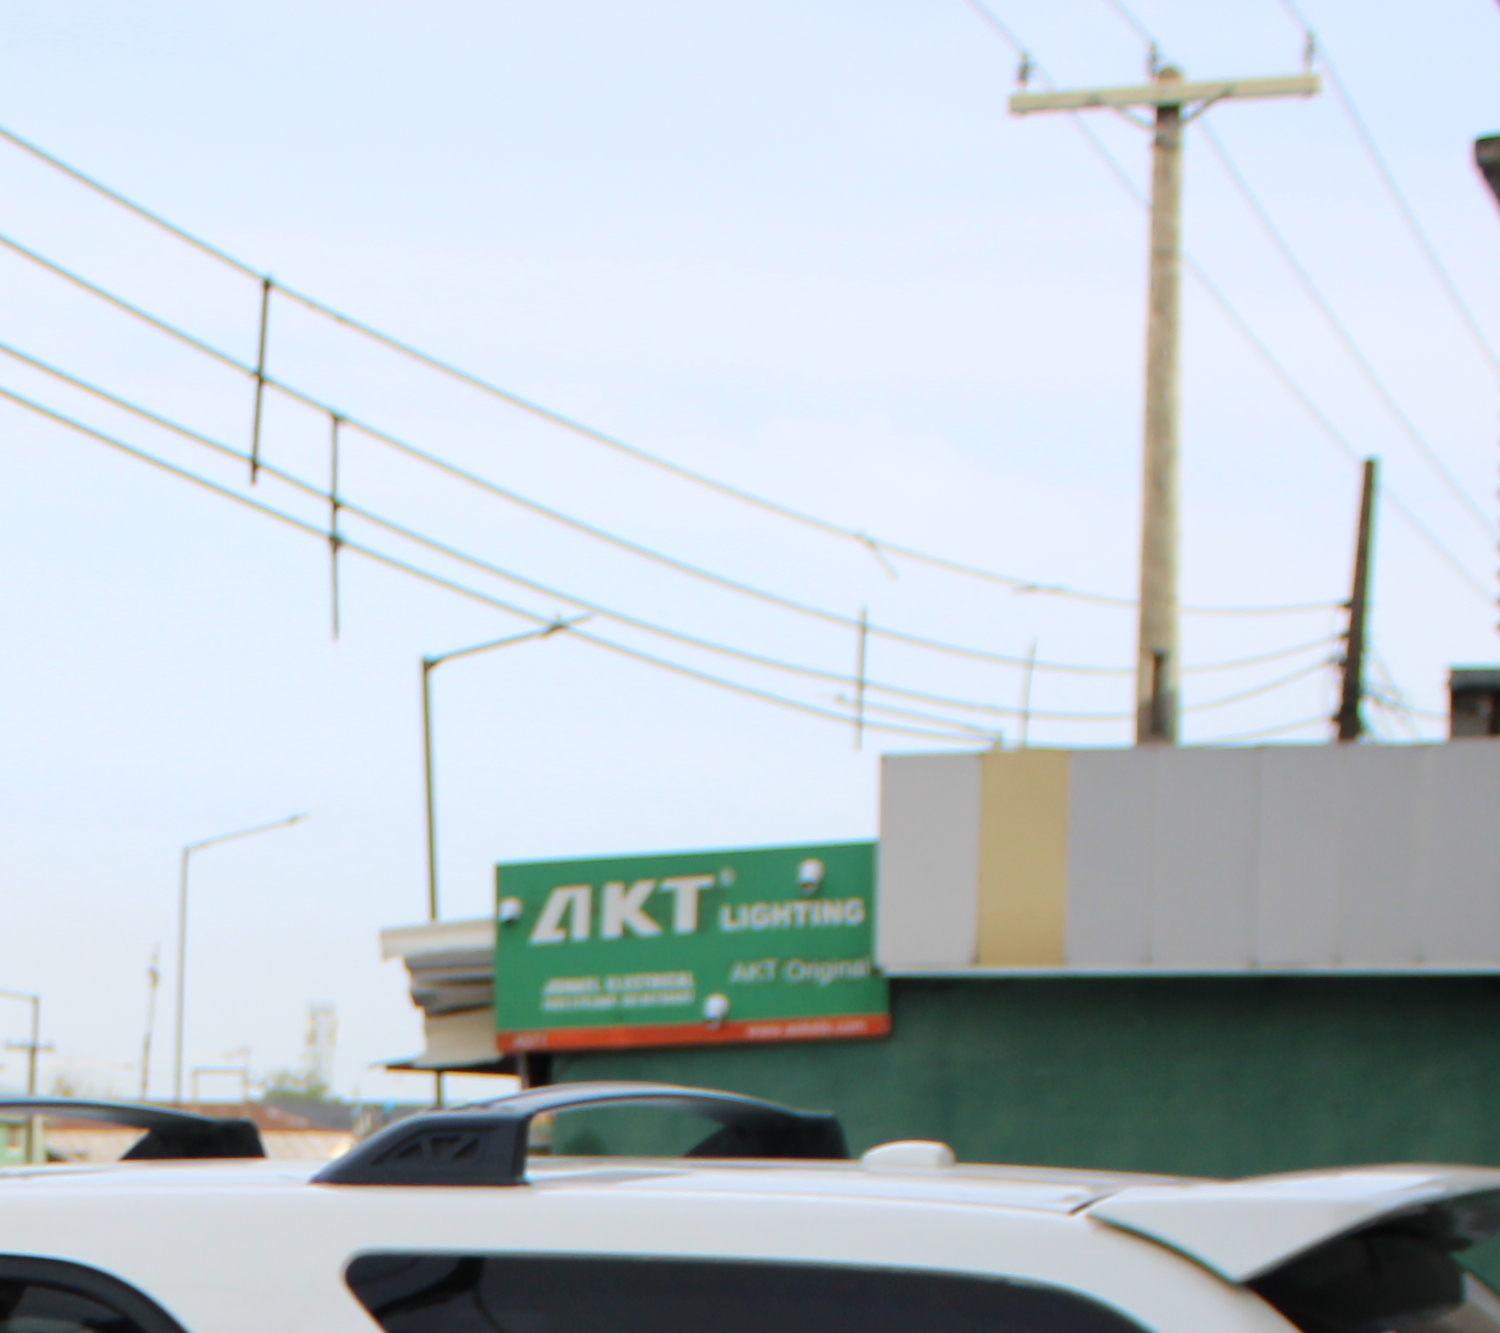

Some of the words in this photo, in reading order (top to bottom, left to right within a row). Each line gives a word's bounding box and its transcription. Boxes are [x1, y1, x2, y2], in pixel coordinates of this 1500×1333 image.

[529, 873, 716, 945] AKT
[719, 897, 865, 932] LIGHTING
[729, 957, 779, 984] AKT
